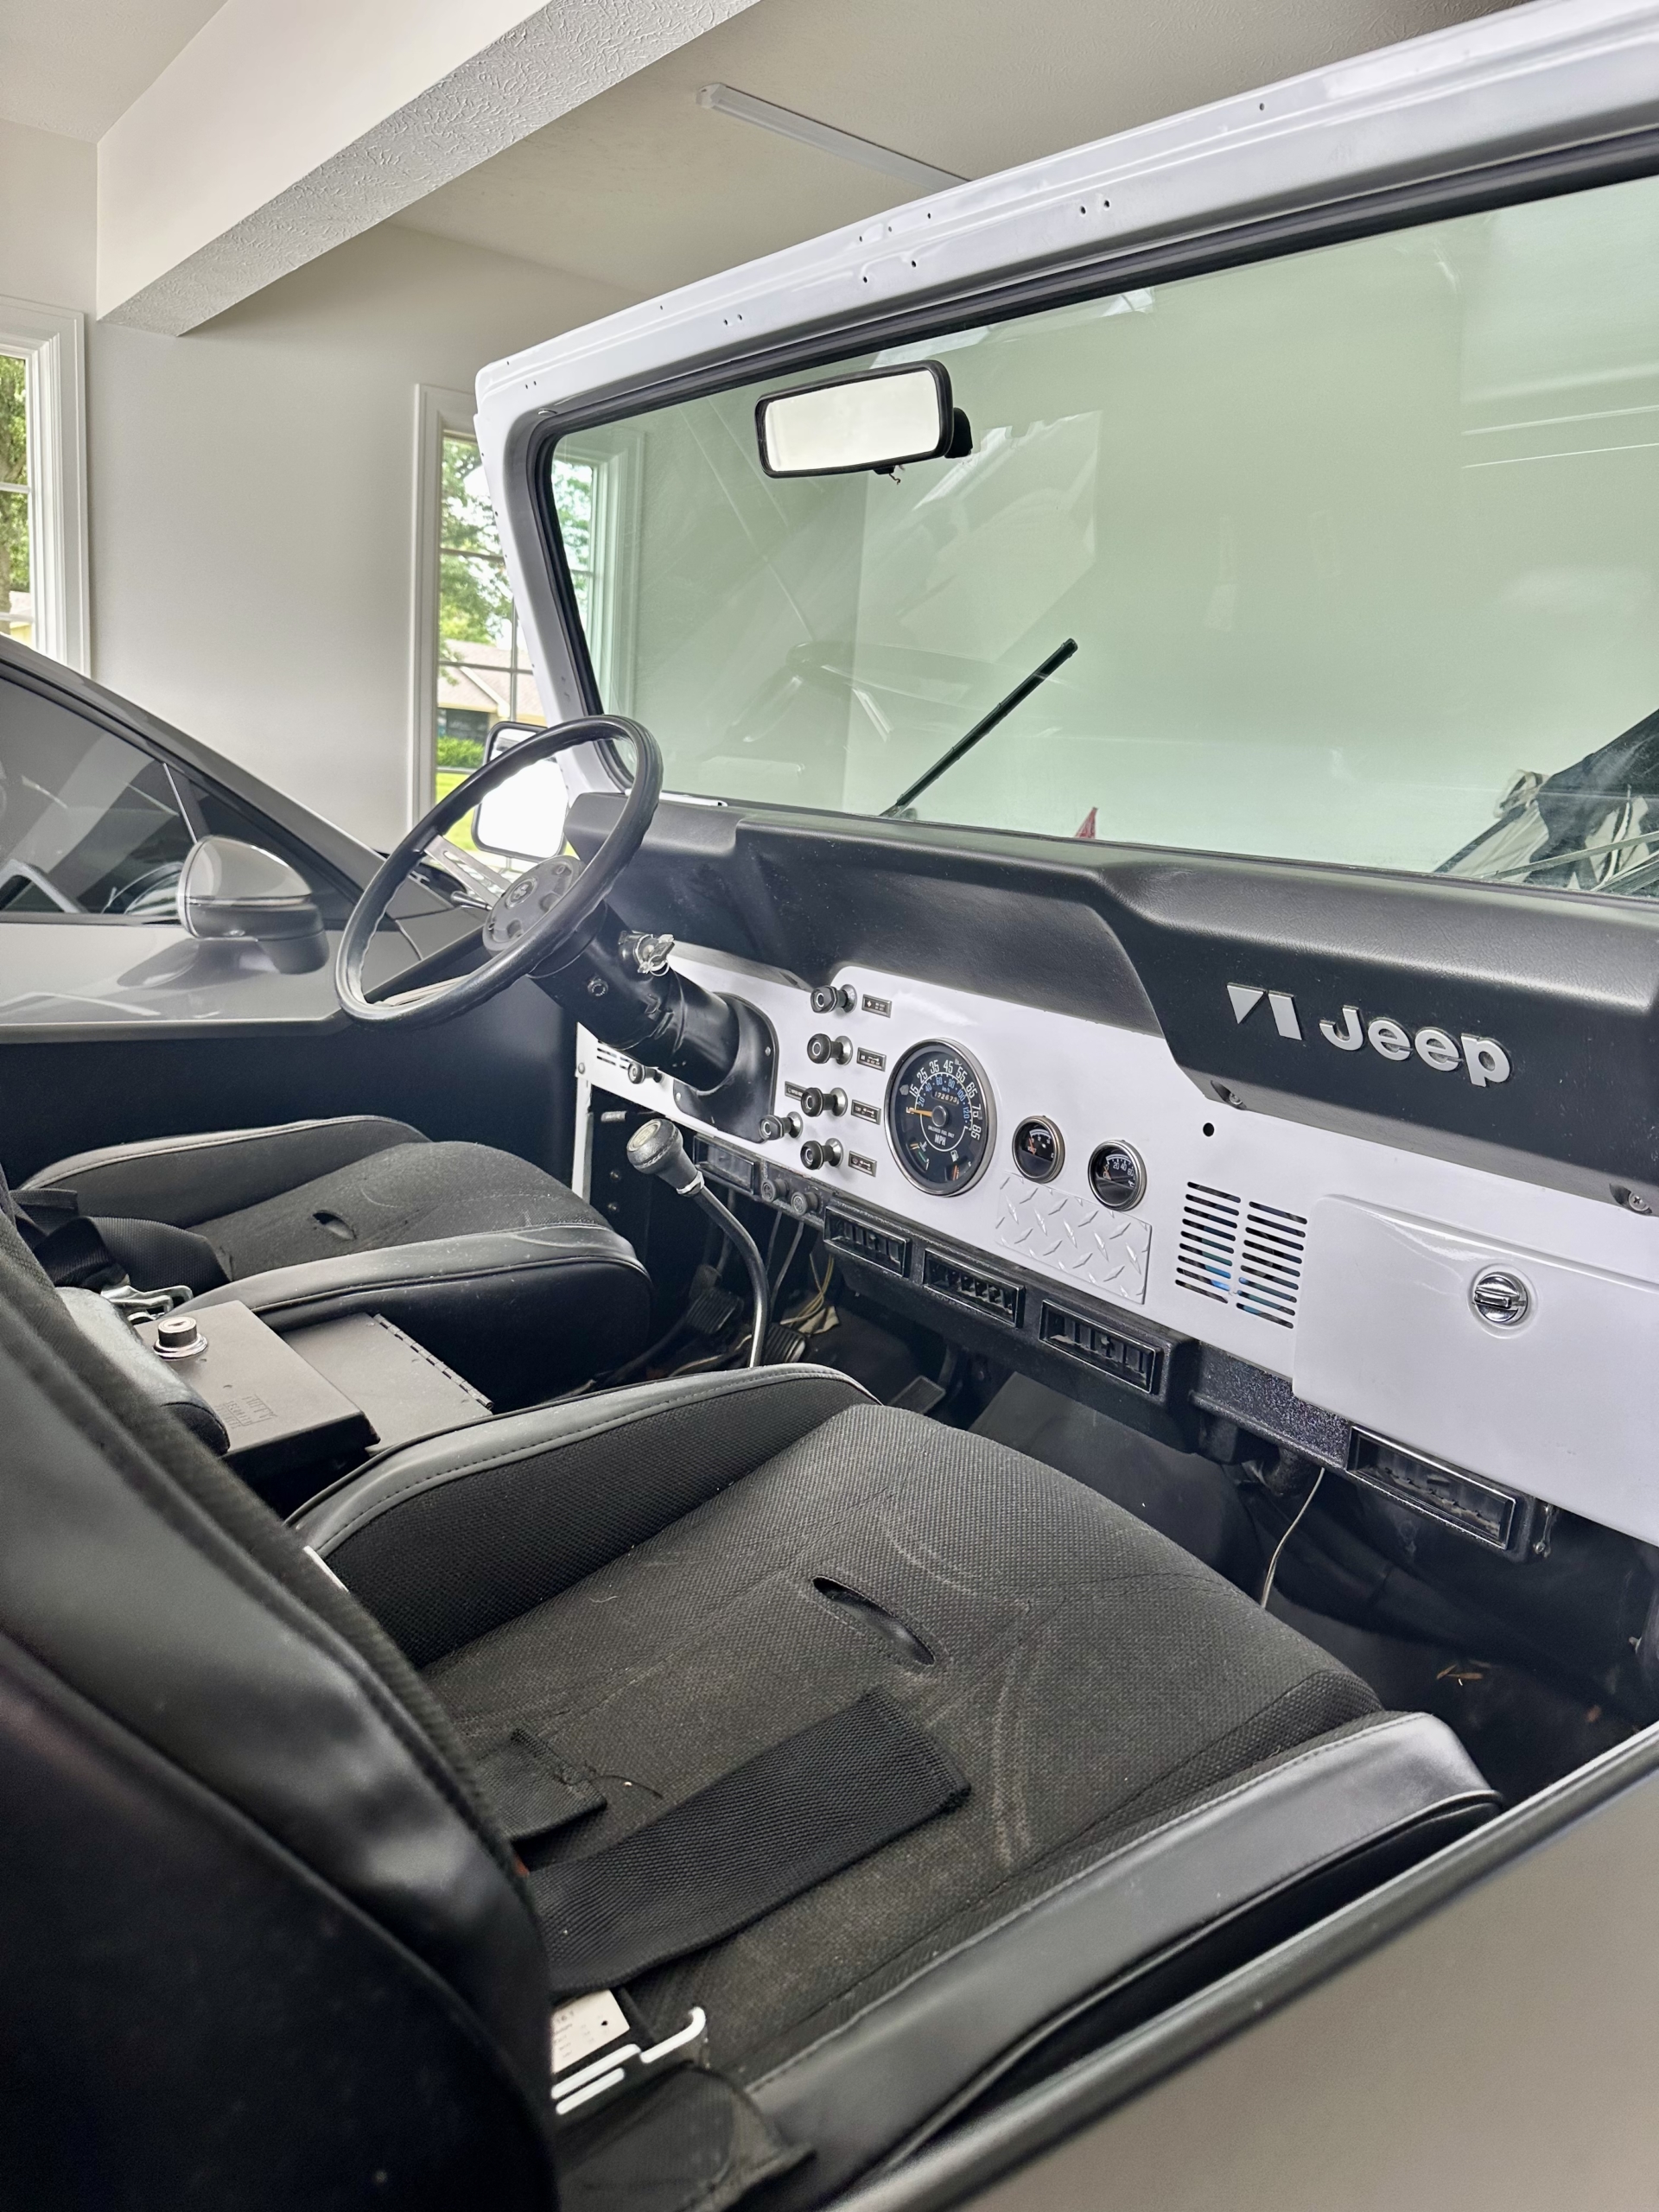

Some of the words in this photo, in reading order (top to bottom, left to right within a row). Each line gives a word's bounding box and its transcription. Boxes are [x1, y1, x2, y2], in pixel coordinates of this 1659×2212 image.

[1319, 1005, 1512, 1087] Jeep
[929, 1059, 940, 1074] 35
[944, 1059, 954, 1073] 45
[917, 1067, 928, 1084] 25
[936, 1076, 944, 1085] 60
[956, 1066, 968, 1083] 55
[909, 1084, 919, 1097] 15
[957, 1089, 966, 1102] 100
[966, 1082, 978, 1098] 65
[970, 1124, 982, 1141] 85
[934, 1134, 946, 1147] MPH
[1113, 1161, 1120, 1170] 20
[1121, 1163, 1127, 1172] 40
[1127, 1167, 1134, 1177] 60
